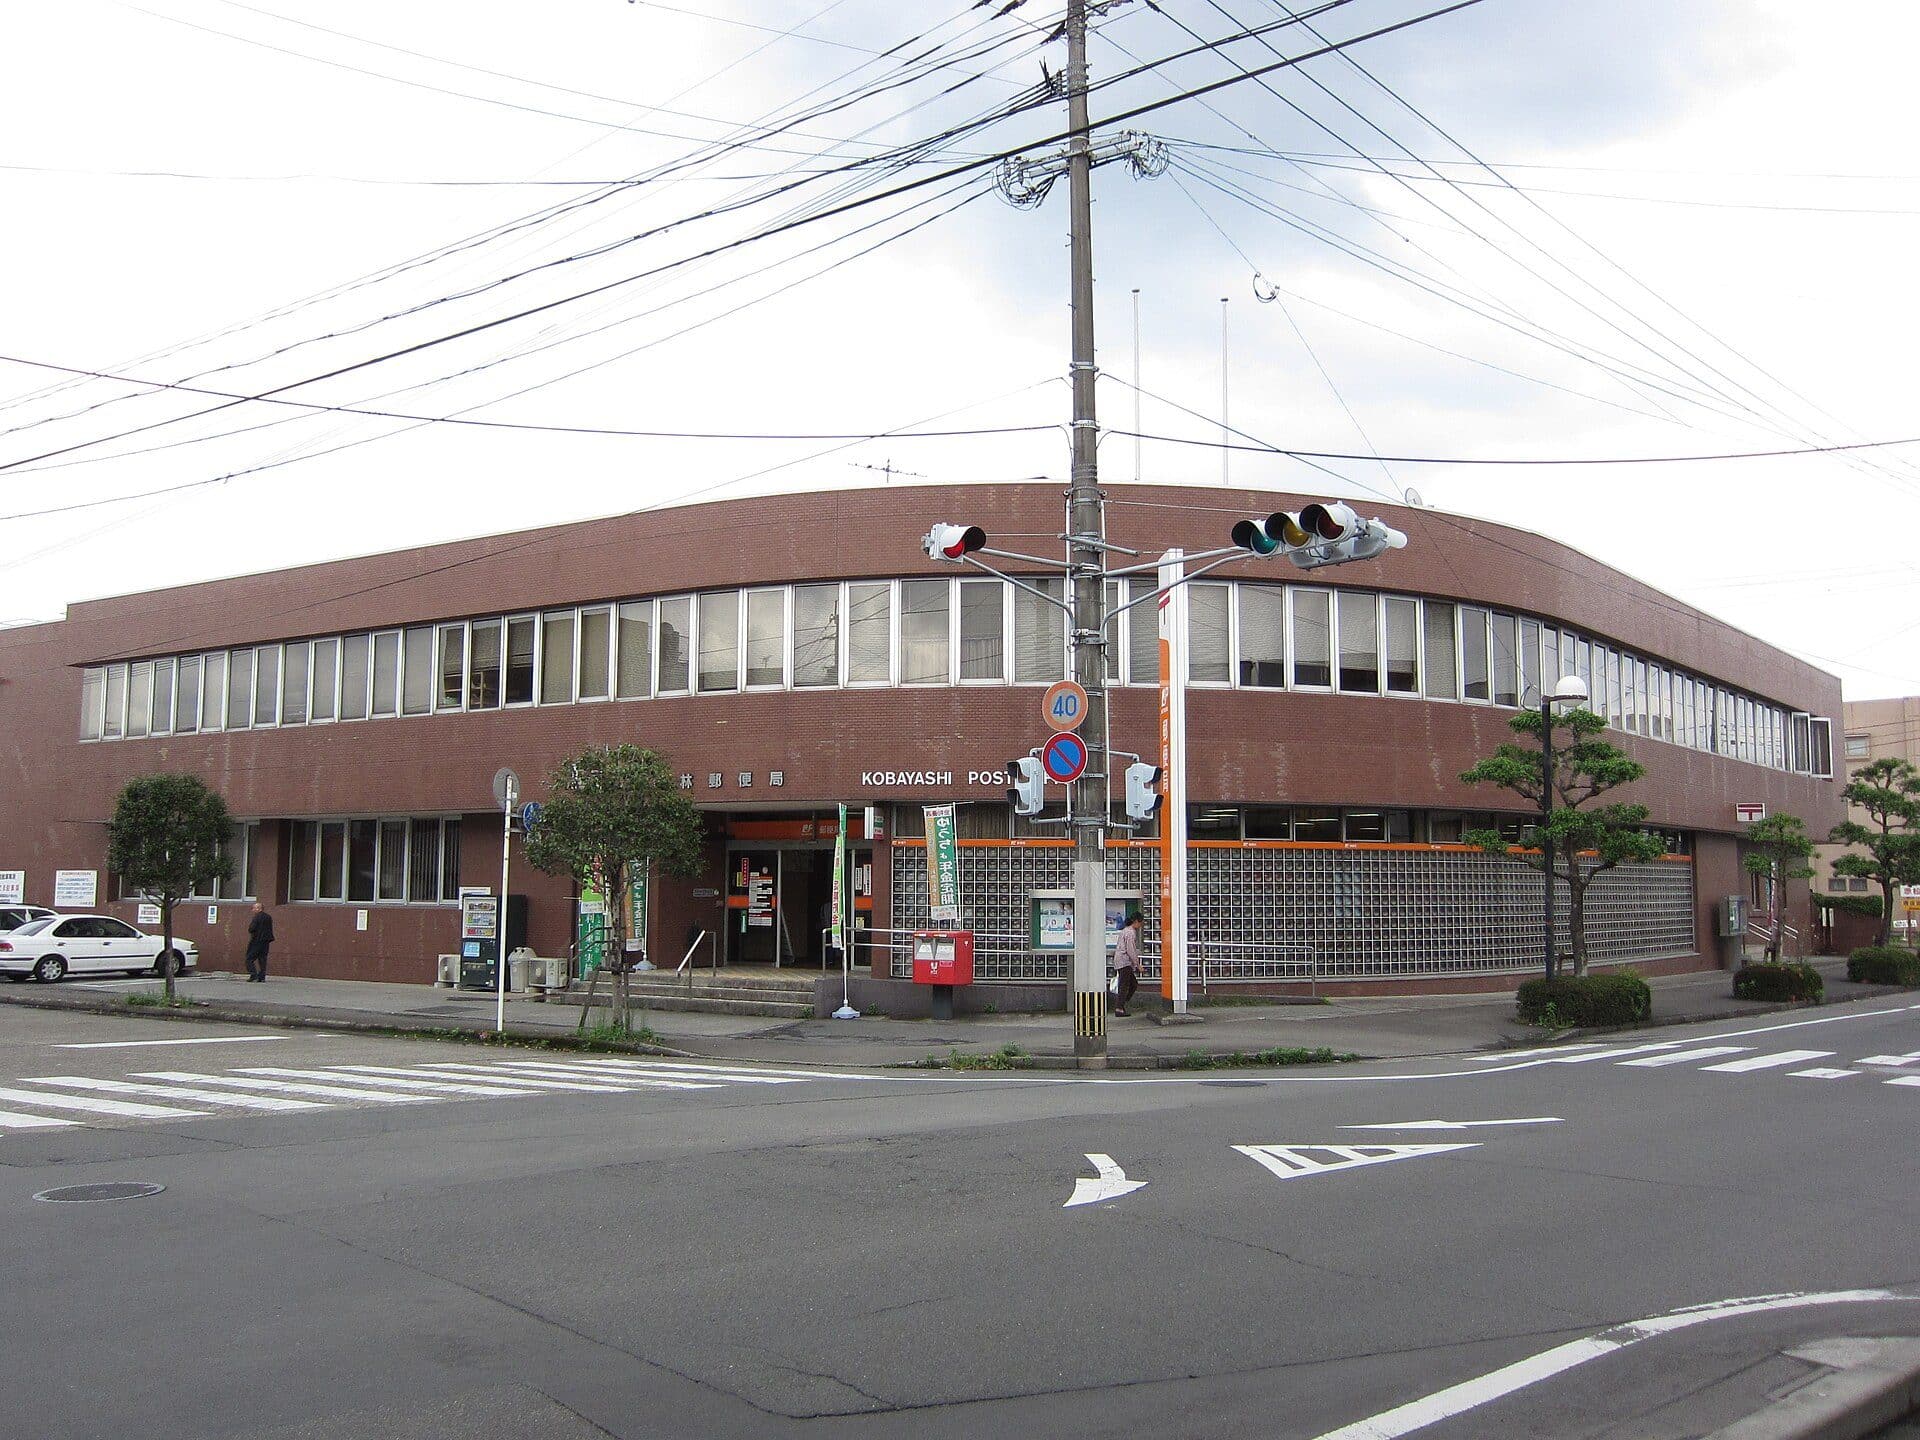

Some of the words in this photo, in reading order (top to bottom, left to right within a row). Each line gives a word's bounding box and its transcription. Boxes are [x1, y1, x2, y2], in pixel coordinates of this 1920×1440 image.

[1053, 695, 1077, 717] 40
[862, 771, 952, 786] KOBAYASHI
[968, 771, 1011, 785] POST
